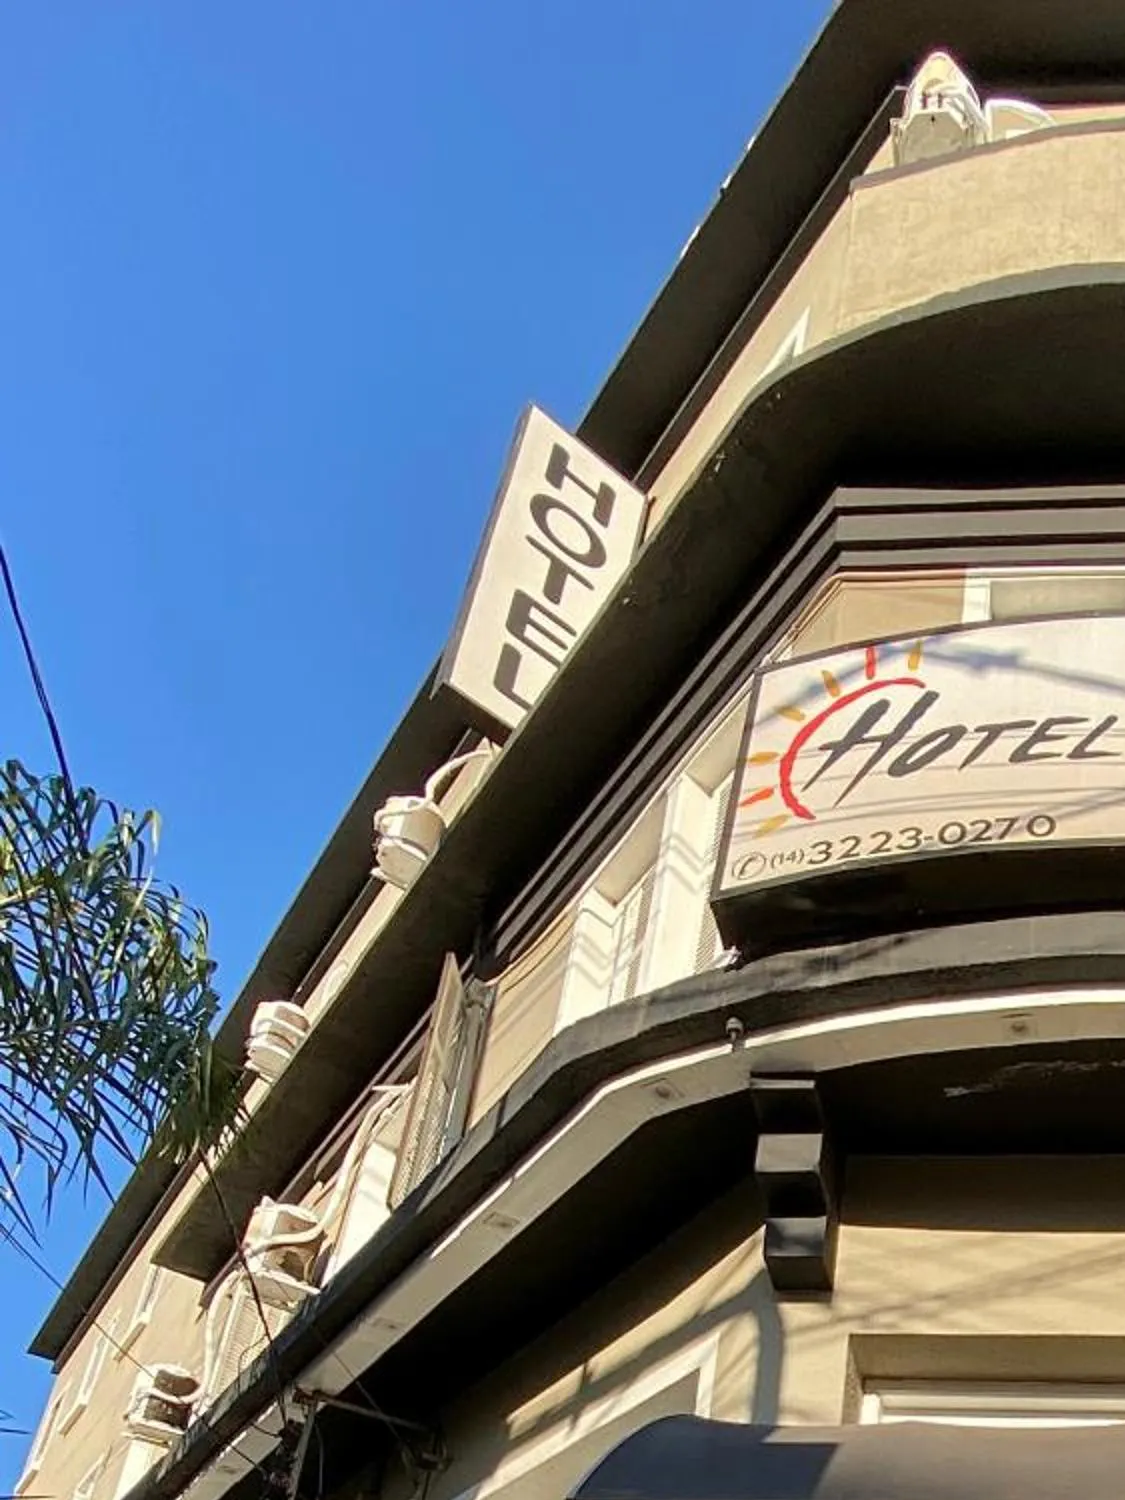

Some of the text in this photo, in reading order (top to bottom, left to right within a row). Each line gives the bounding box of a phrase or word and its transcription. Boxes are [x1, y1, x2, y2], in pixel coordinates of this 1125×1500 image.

[493, 442, 617, 711] HOTEL
[801, 690, 1123, 808] HOTEL
[770, 814, 1056, 869] (14) 3223-0270
